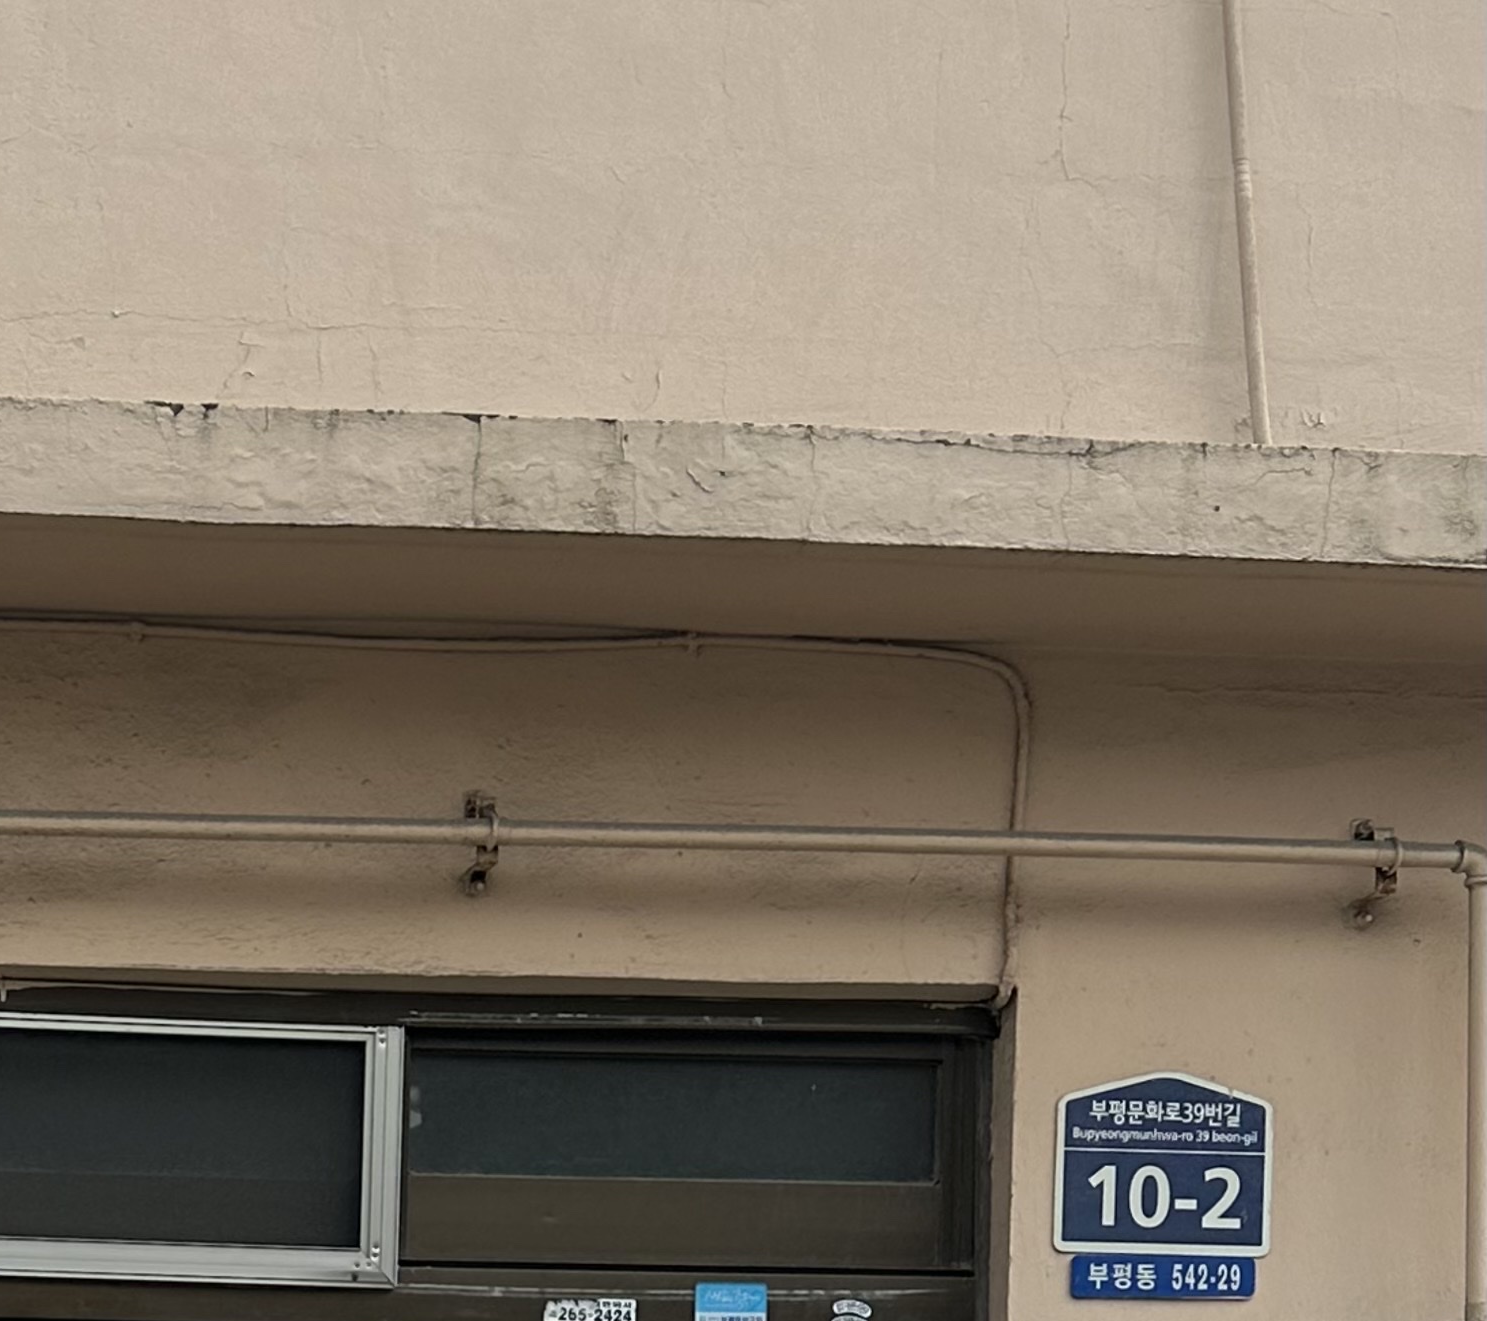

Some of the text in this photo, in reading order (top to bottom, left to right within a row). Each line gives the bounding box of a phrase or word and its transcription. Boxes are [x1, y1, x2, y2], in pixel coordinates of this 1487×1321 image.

[1088, 1100, 1242, 1128] 부평문화로39번길
[1072, 1126, 1259, 1147] Bupyeongmunhwa-ro 39 beon-gil
[1087, 1165, 1242, 1229] 10-2
[1087, 1262, 1157, 1291] 부평동
